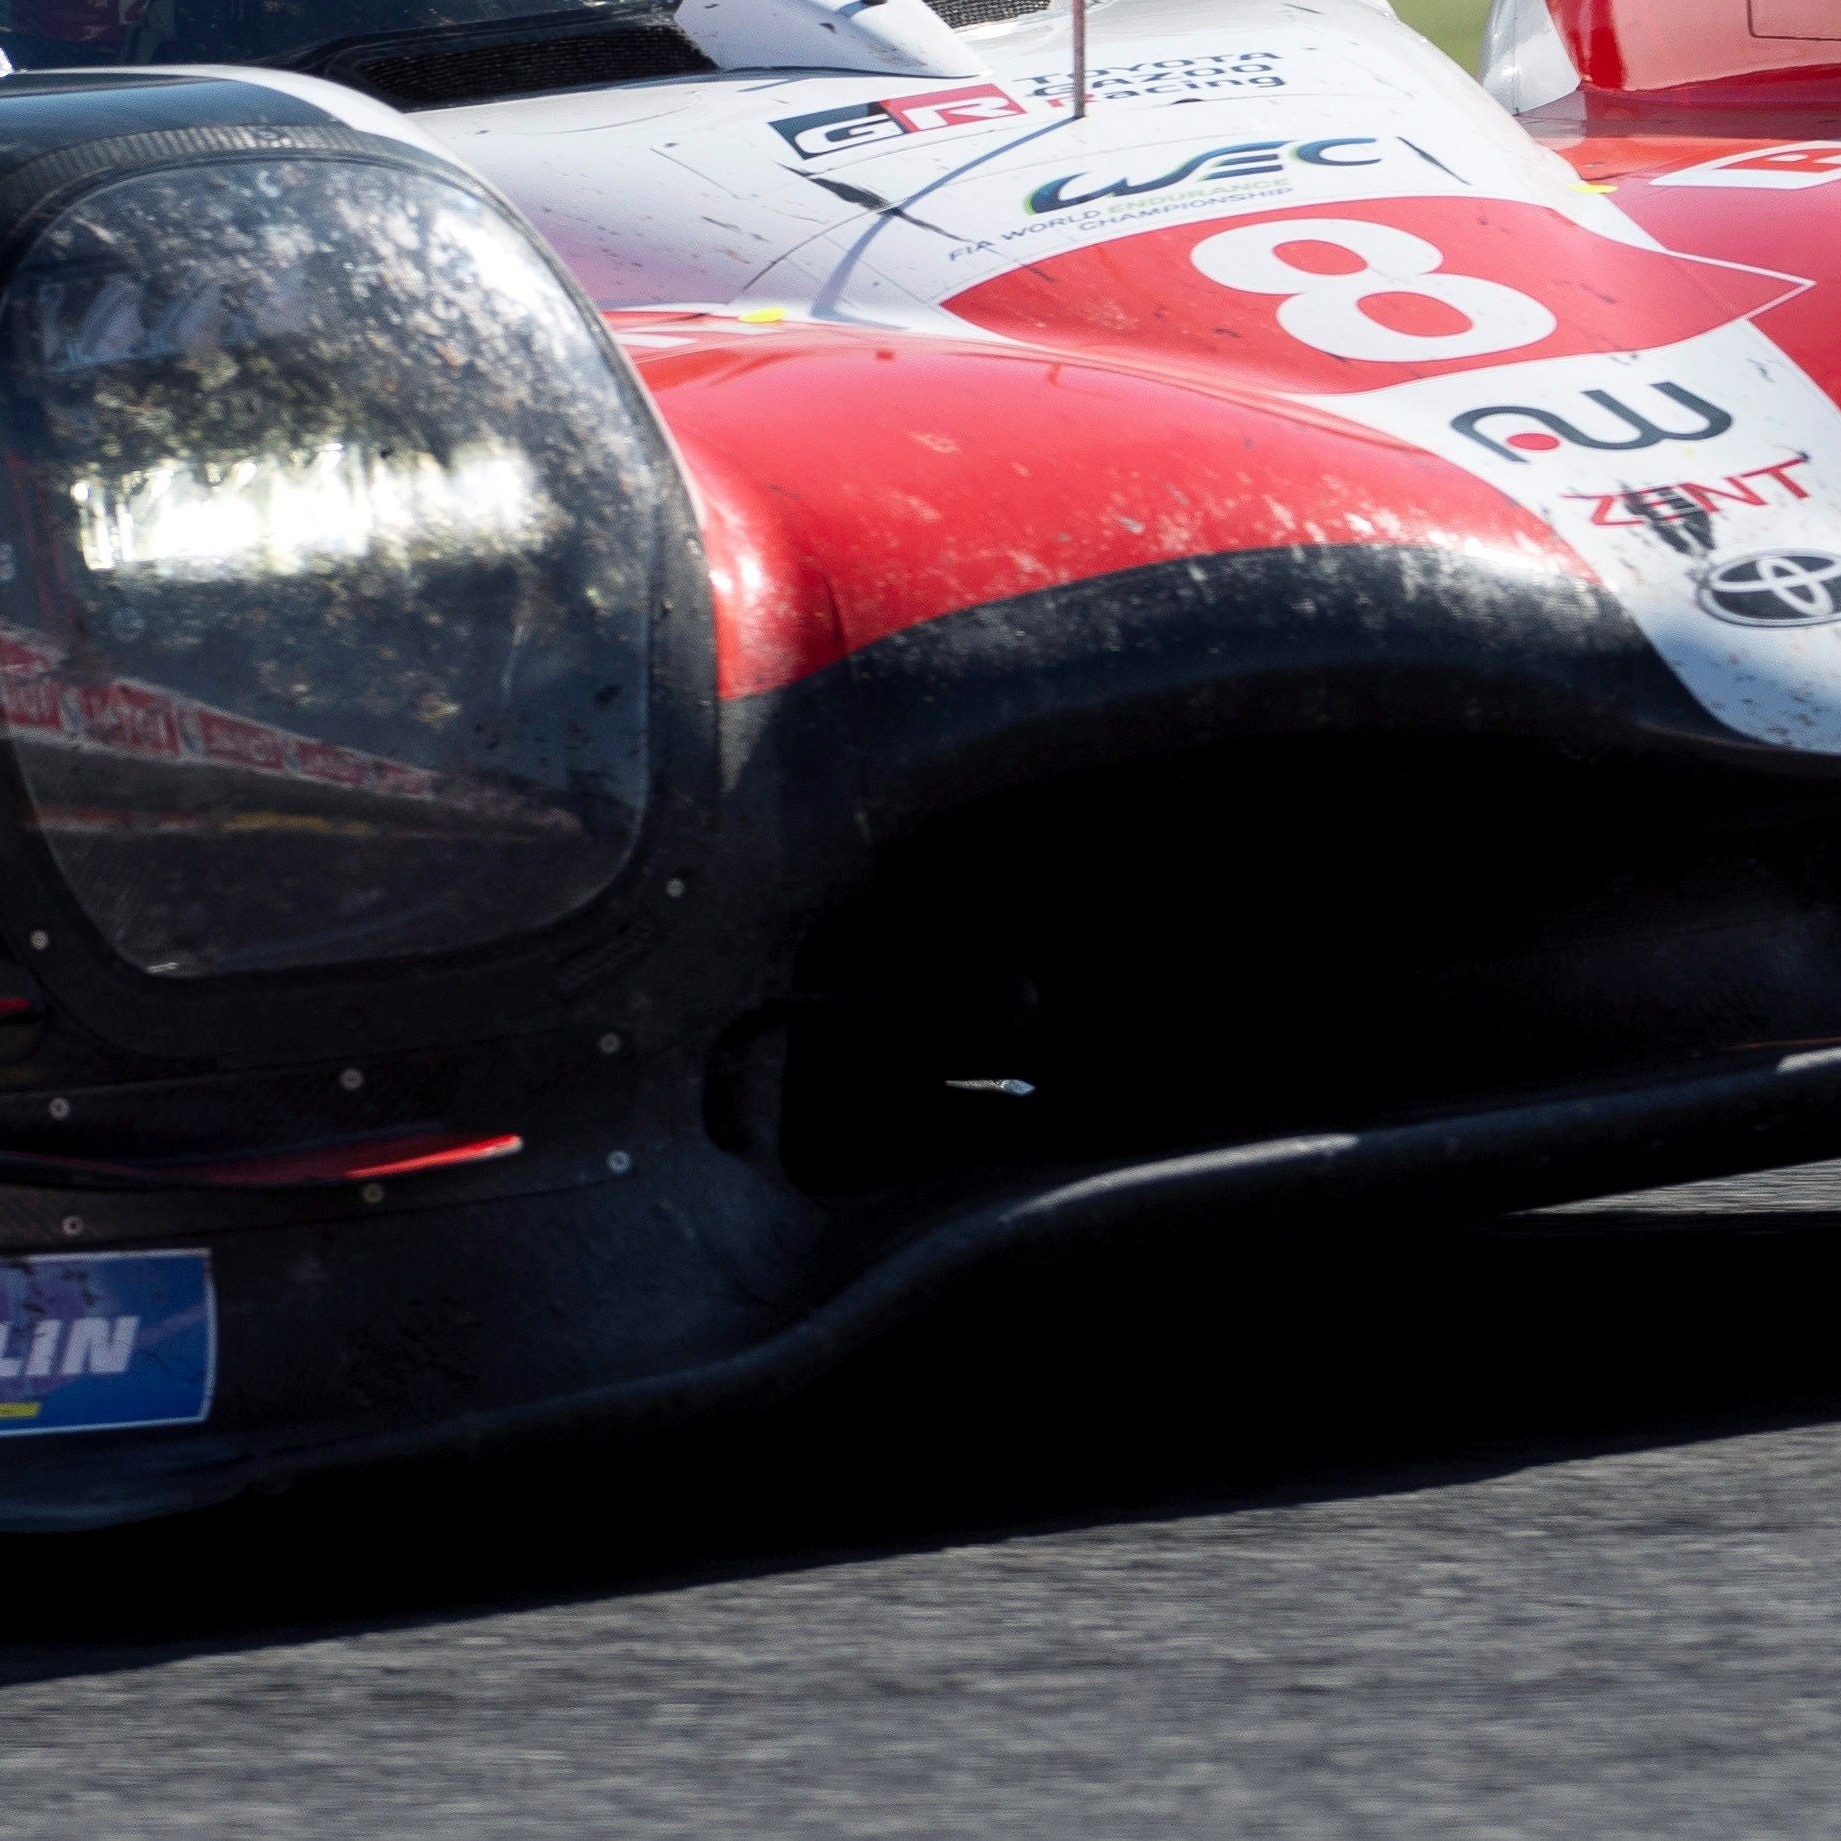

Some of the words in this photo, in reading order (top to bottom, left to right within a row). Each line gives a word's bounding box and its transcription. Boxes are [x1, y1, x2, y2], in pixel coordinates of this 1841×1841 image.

[1013, 52, 1282, 84] TOYOTA
[1025, 63, 1273, 97] GAZOO
[1046, 76, 1286, 108] Racing
[791, 93, 1017, 155] GR
[1023, 136, 1382, 216] WEC
[949, 240, 993, 262] FIA
[1000, 210, 1100, 240] WORLD
[1108, 177, 1291, 215] ENDURANCE
[1078, 187, 1293, 231] CHAMPIONSHIP
[1190, 218, 1557, 362] 8
[1560, 454, 1811, 527] ZENT
